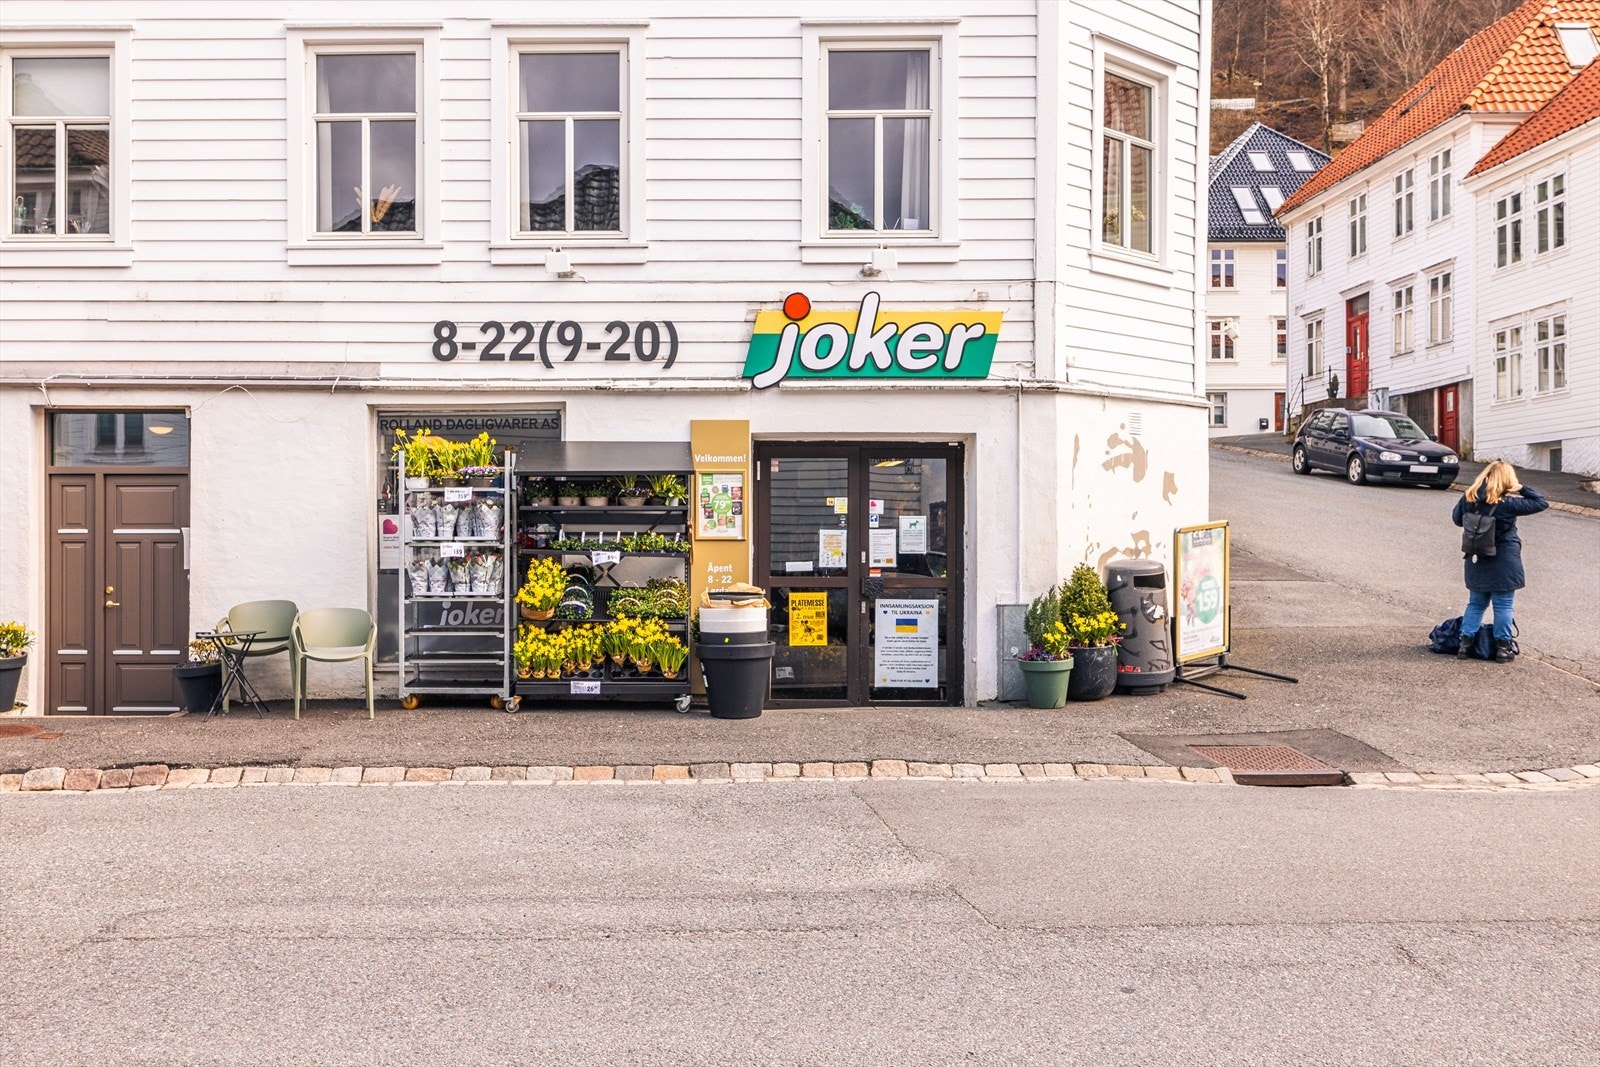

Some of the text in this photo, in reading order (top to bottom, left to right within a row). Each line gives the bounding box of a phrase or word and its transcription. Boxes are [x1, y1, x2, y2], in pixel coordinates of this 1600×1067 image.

[432, 320, 679, 369] 8-22(9-20)
[752, 291, 987, 389] joker
[380, 417, 559, 430] ROLLAND DAGLIGVARER AS
[694, 454, 747, 463] Velkommen!
[707, 562, 733, 573] Åpent
[707, 575, 714, 584] 8
[721, 575, 732, 584] 22
[791, 599, 825, 607] PLATEMESSE
[1196, 591, 1218, 612] 159
